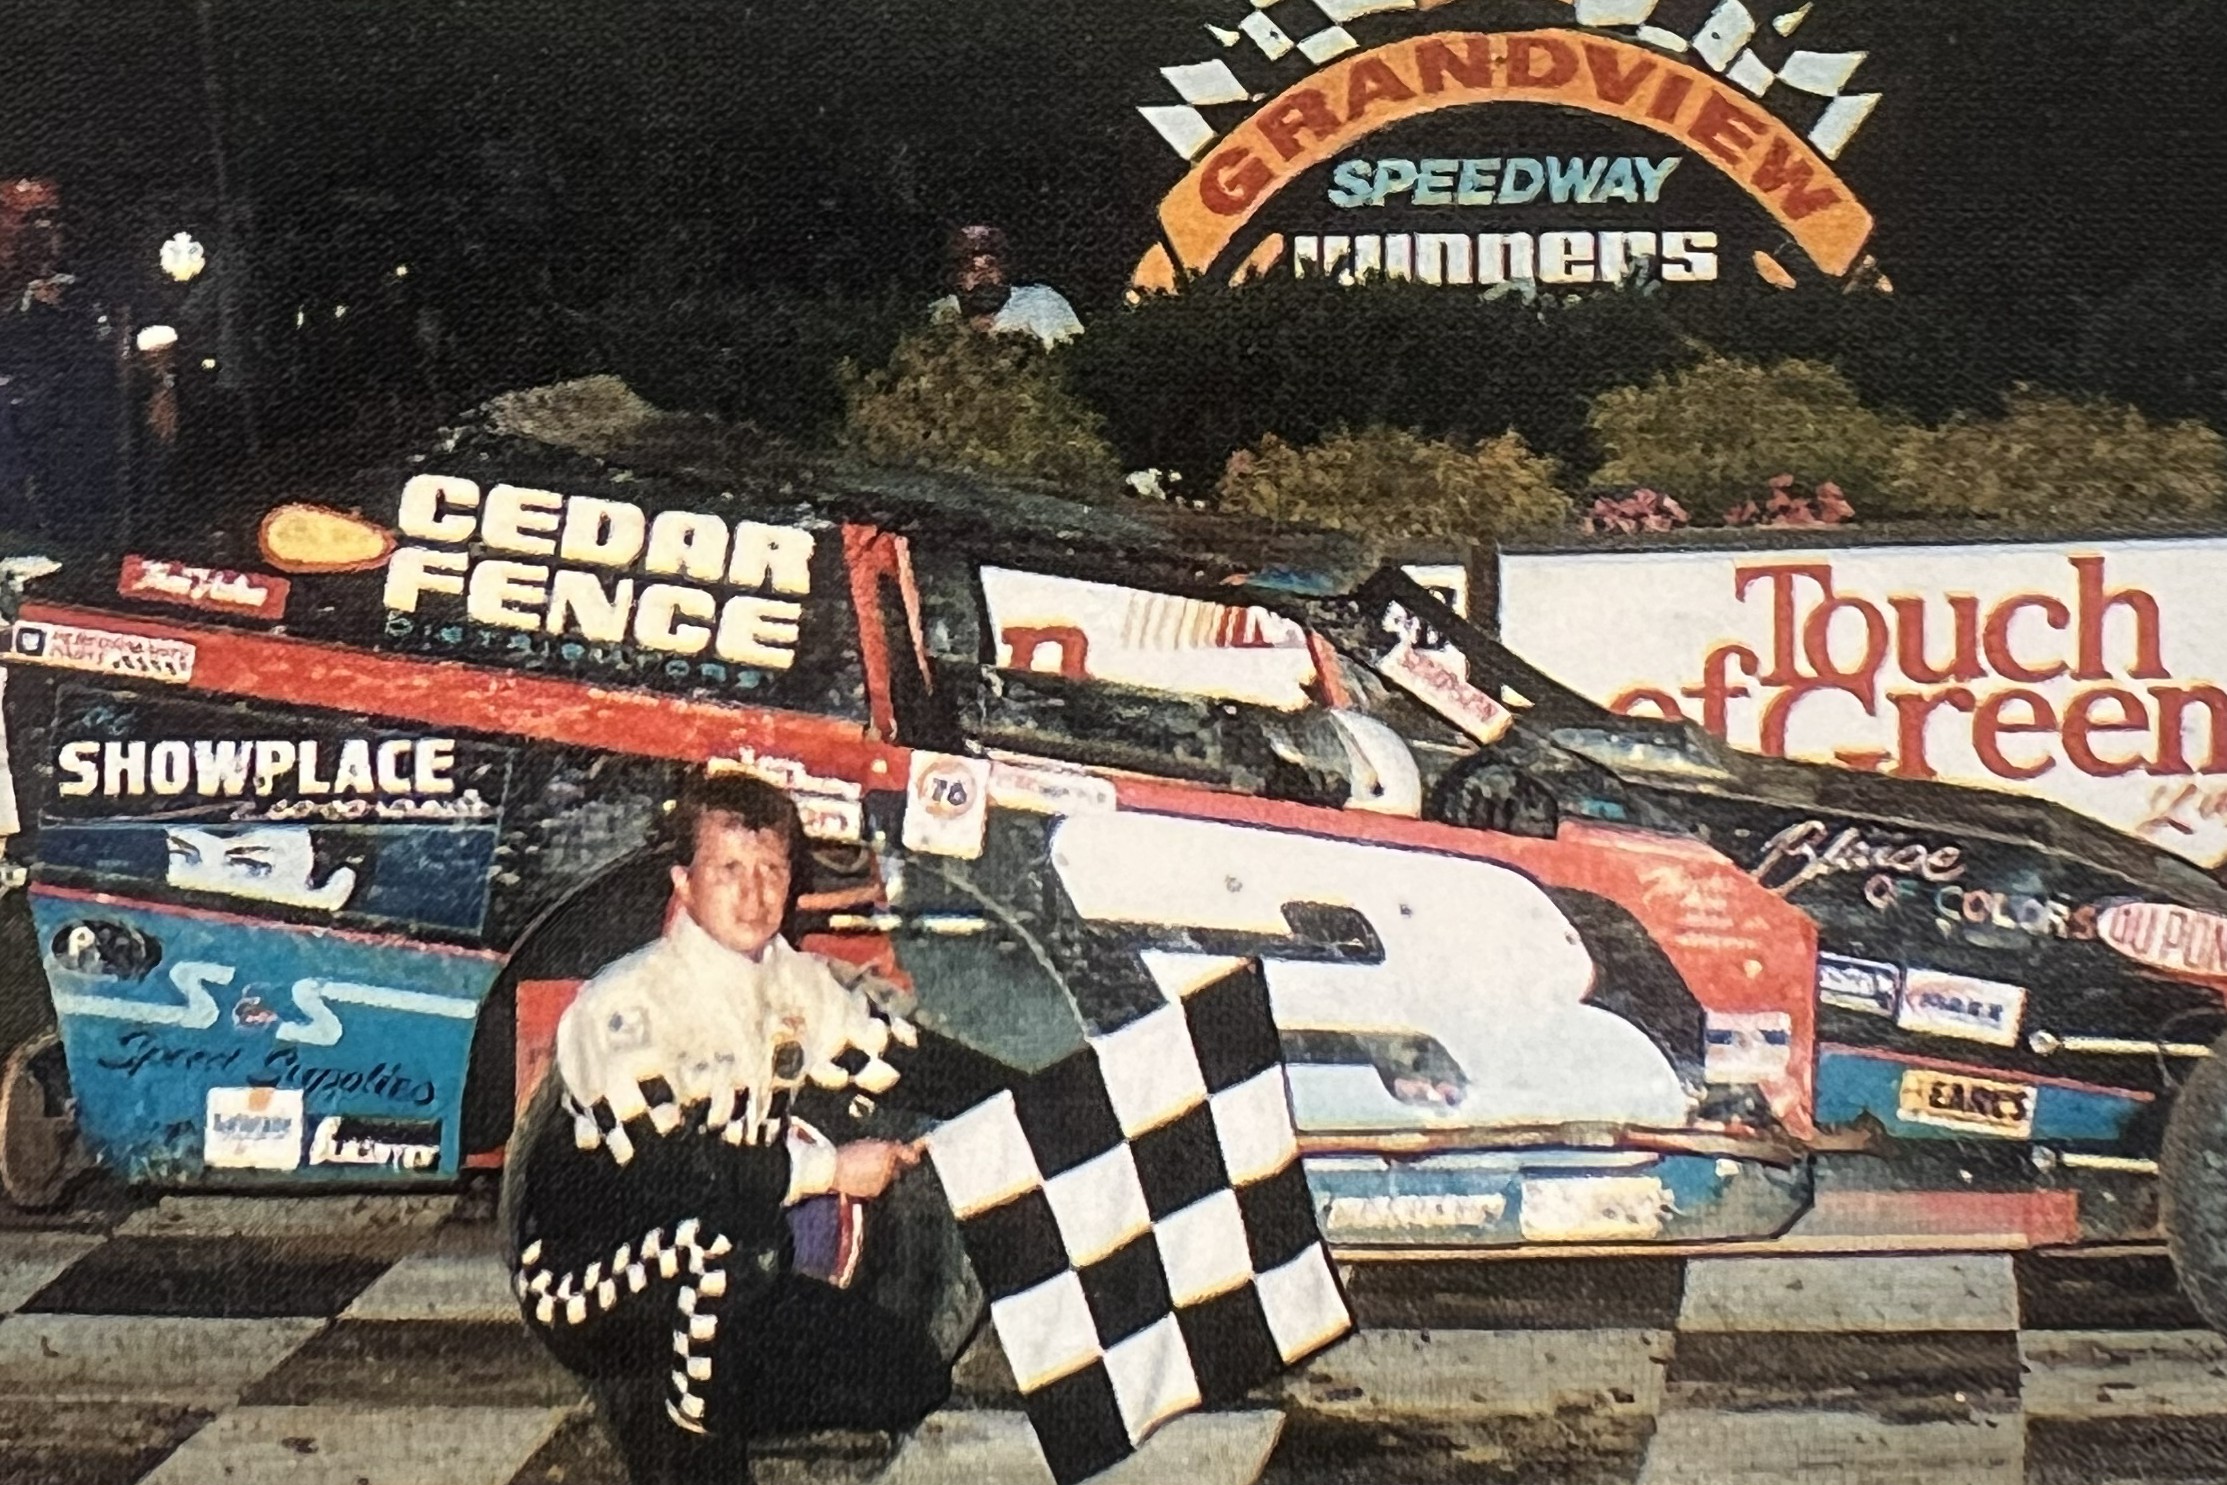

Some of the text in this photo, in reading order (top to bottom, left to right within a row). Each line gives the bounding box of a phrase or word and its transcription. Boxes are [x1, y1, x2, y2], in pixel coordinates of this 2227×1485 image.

[1200, 31, 1844, 220] GRANDVIEW
[1328, 156, 1682, 208] SPEEDWAY
[399, 474, 815, 594] CEDAR
[384, 547, 801, 669] FENCE
[1735, 556, 2171, 683] Touch
[58, 739, 456, 798] SHOWPLACE
